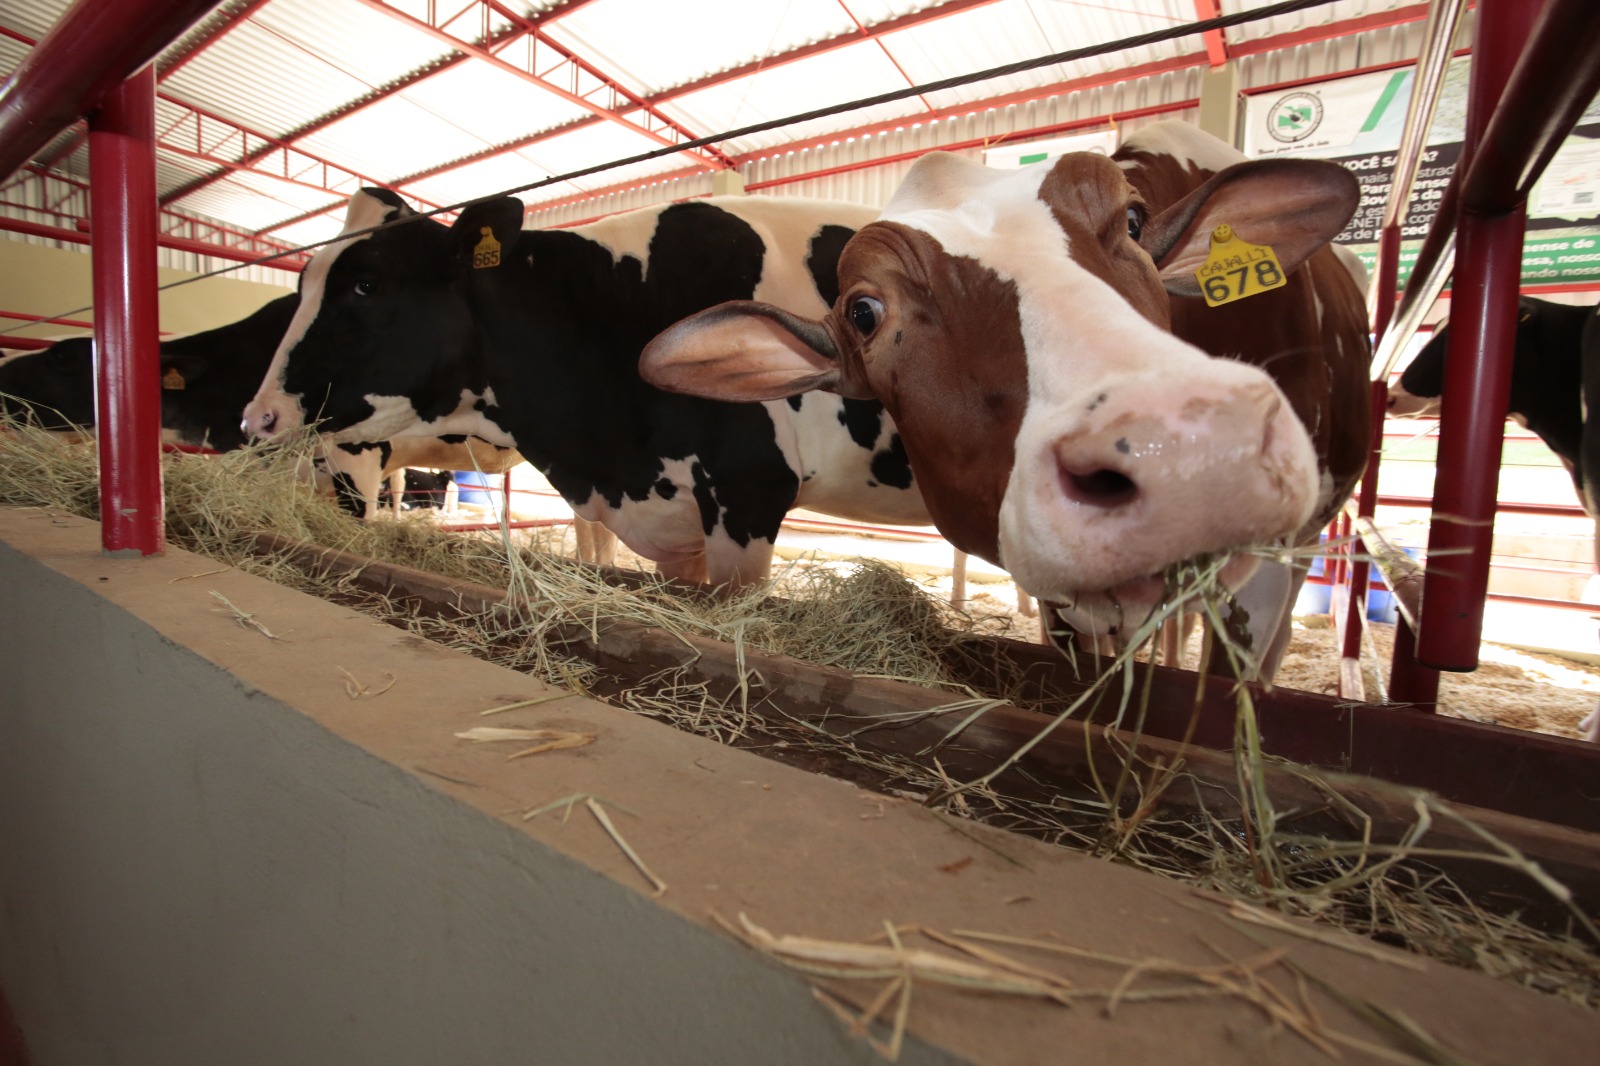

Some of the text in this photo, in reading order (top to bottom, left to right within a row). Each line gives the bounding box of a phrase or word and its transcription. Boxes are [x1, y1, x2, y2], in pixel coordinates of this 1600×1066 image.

[1421, 188, 1443, 201] da
[1353, 229, 1373, 240] de
[1572, 239, 1596, 249] de
[475, 250, 499, 267] 665
[1204, 260, 1282, 302] 678
